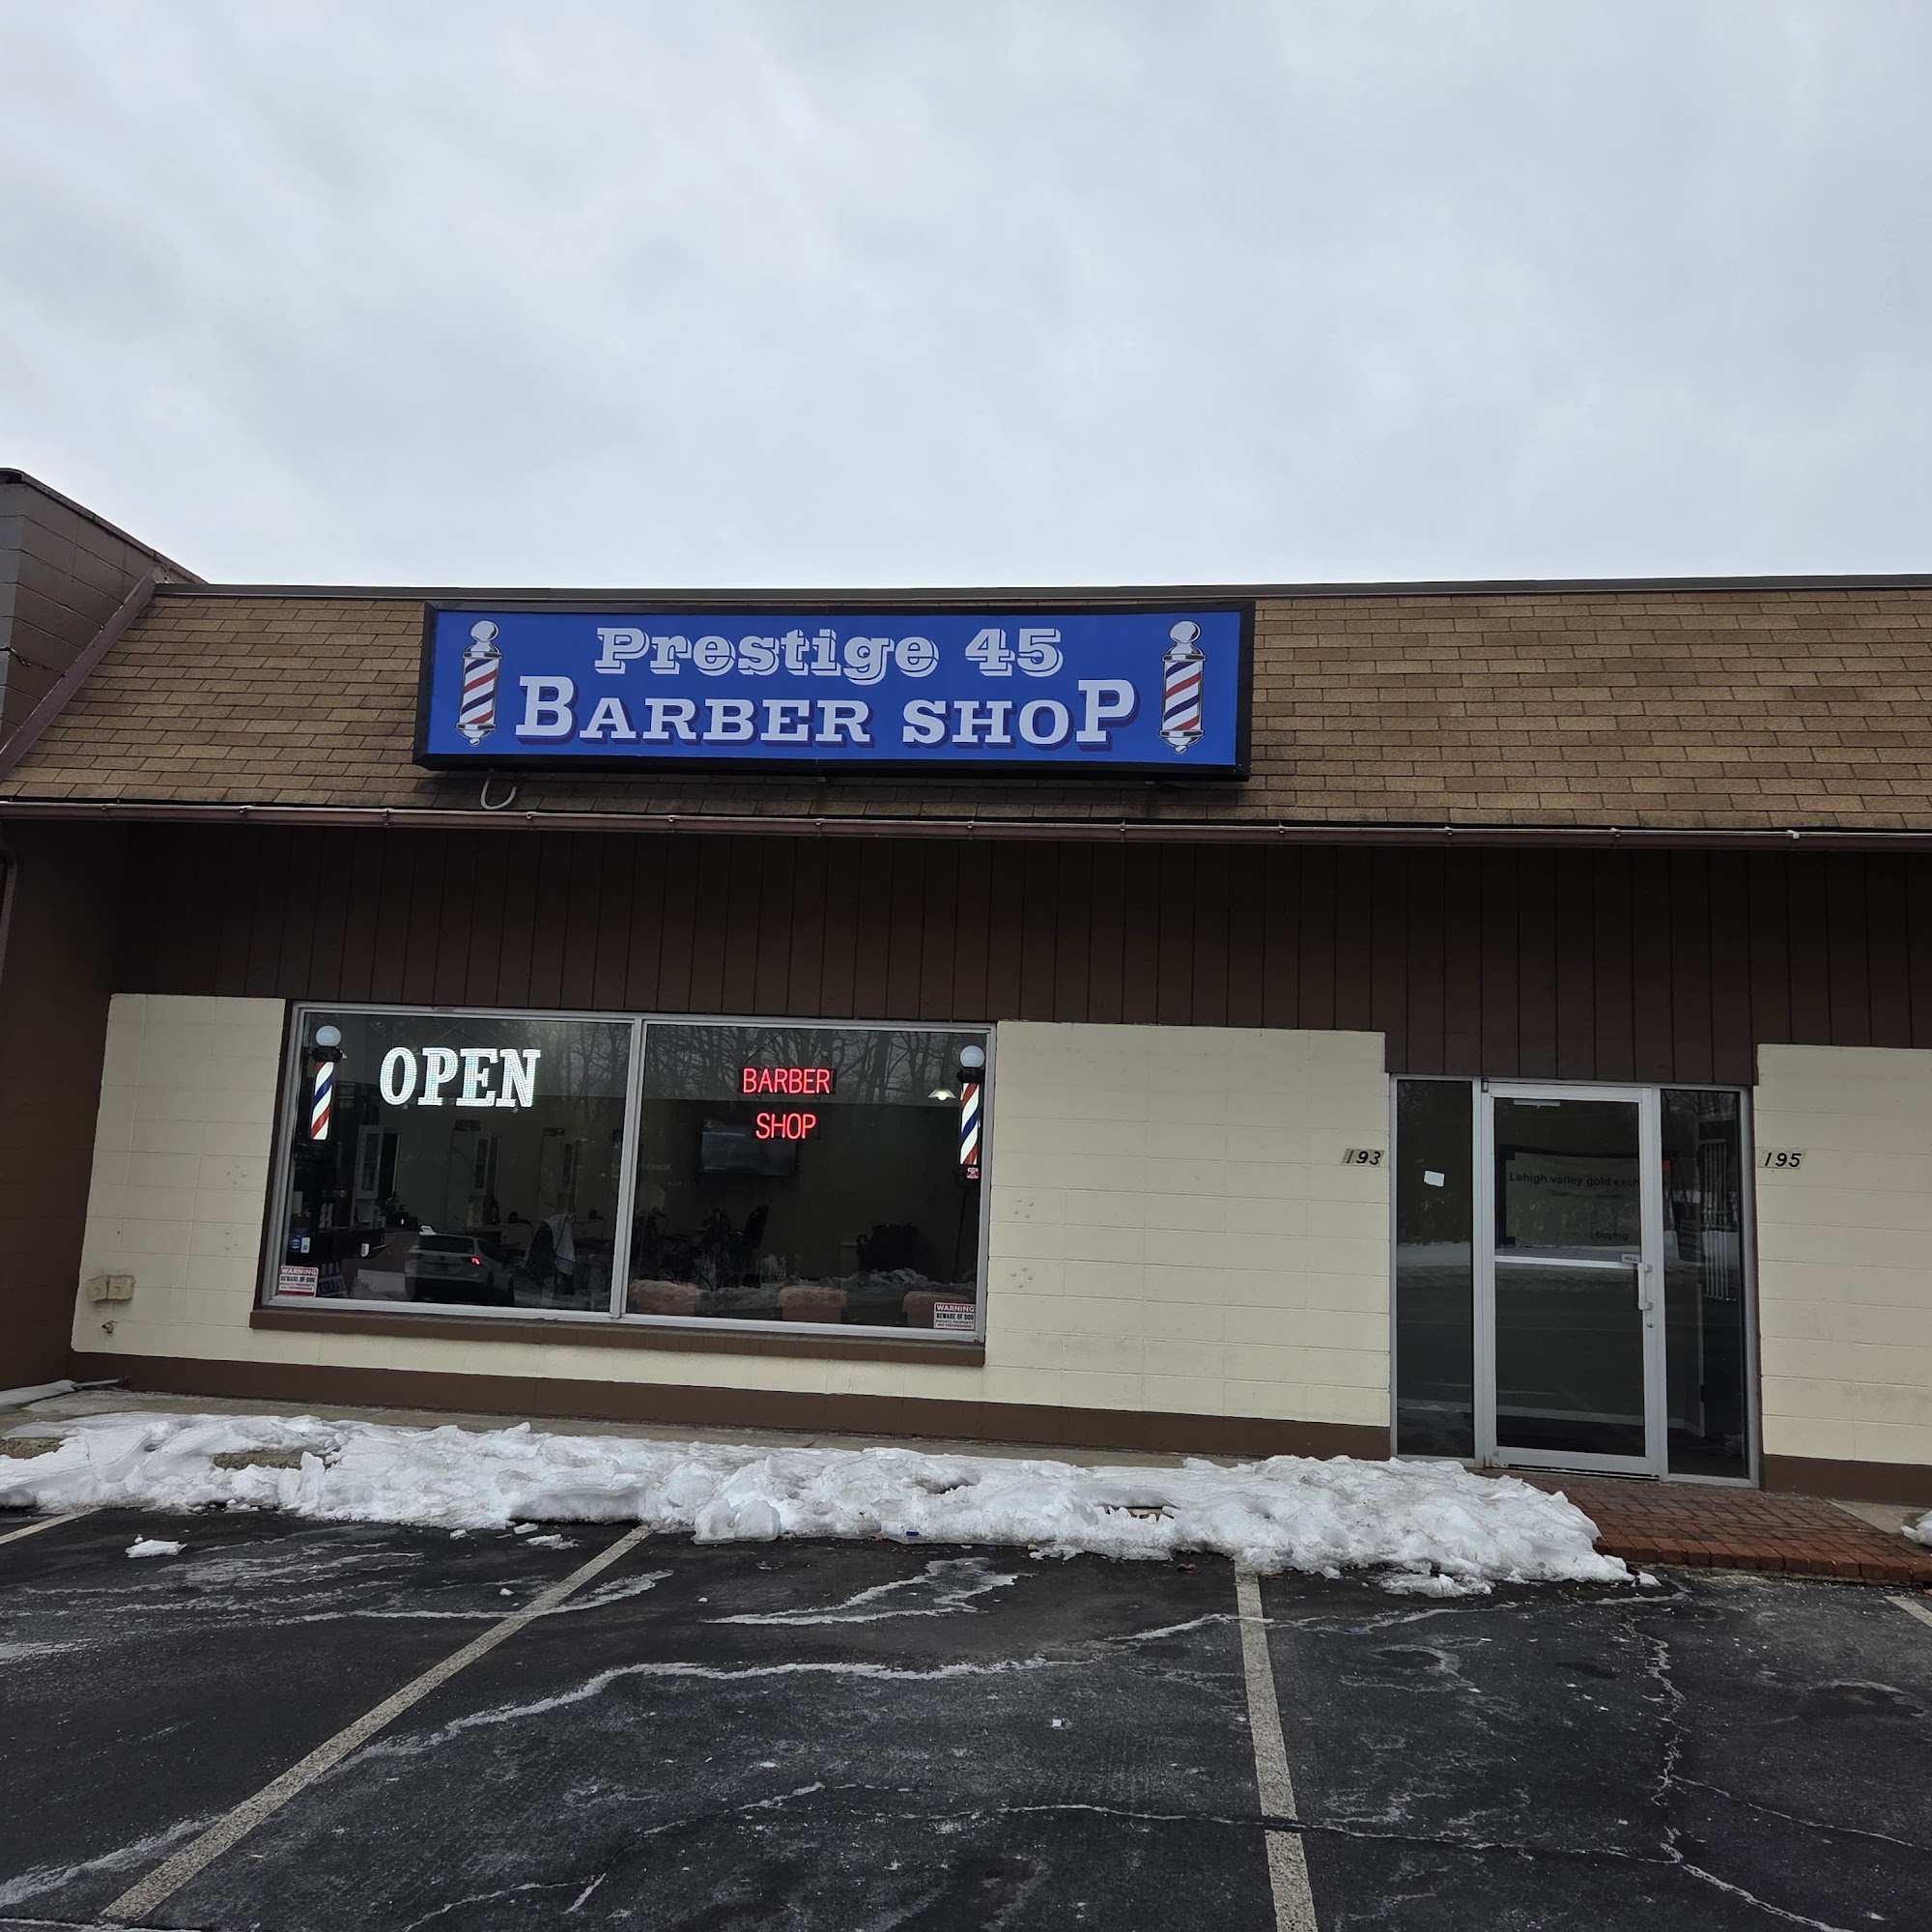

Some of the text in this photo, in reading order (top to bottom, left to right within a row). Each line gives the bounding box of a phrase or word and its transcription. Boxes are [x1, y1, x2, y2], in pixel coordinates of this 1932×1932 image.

[593, 626, 1064, 686] Prestige 45
[515, 675, 1138, 748] BARBER SHOP
[380, 1046, 542, 1108] OPEN
[743, 1067, 831, 1094] BARBER
[755, 1112, 816, 1140] SHOP
[1346, 1150, 1381, 1165] 193
[1764, 1151, 1803, 1168] 195
[1509, 1172, 1548, 1185] Lehigh
[1550, 1175, 1583, 1187] valley
[1586, 1176, 1611, 1187] gold
[1595, 1231, 1629, 1241] buying
